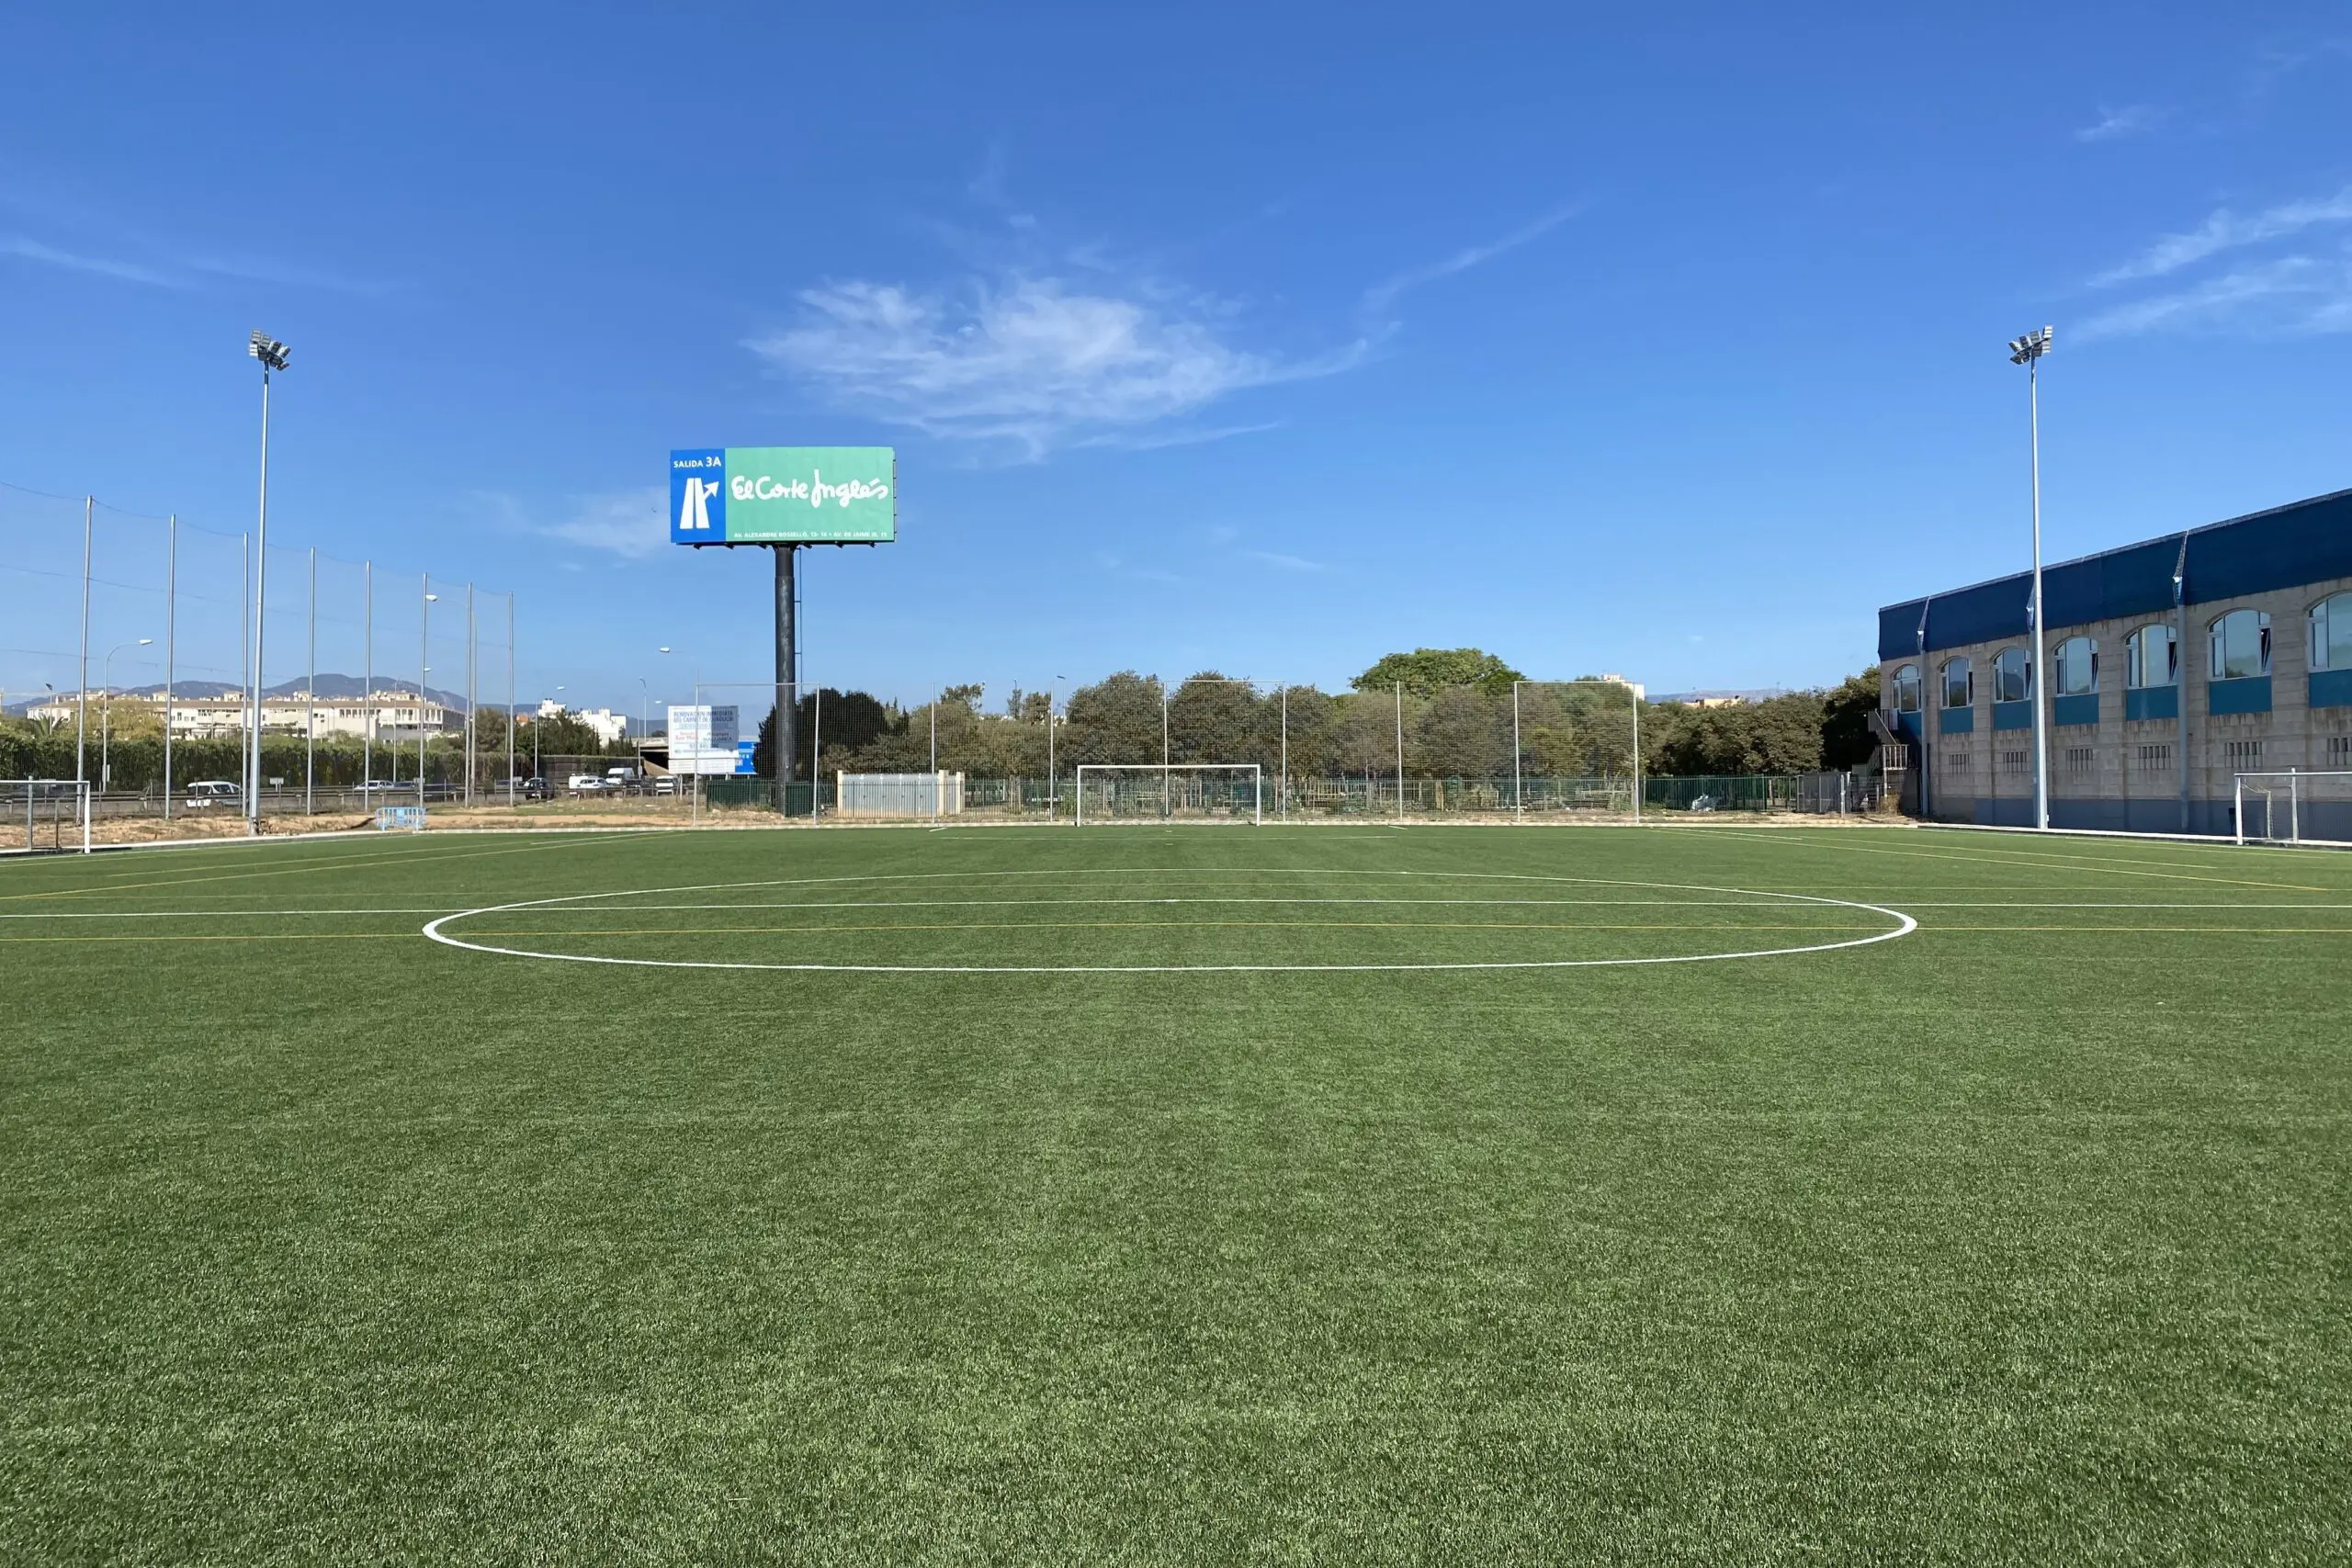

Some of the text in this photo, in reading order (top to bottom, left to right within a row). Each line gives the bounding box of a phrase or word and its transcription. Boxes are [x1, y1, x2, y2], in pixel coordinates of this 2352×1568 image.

[673, 456, 722, 468] SALIDA 3A
[730, 468, 889, 508] El Corte Inglés
